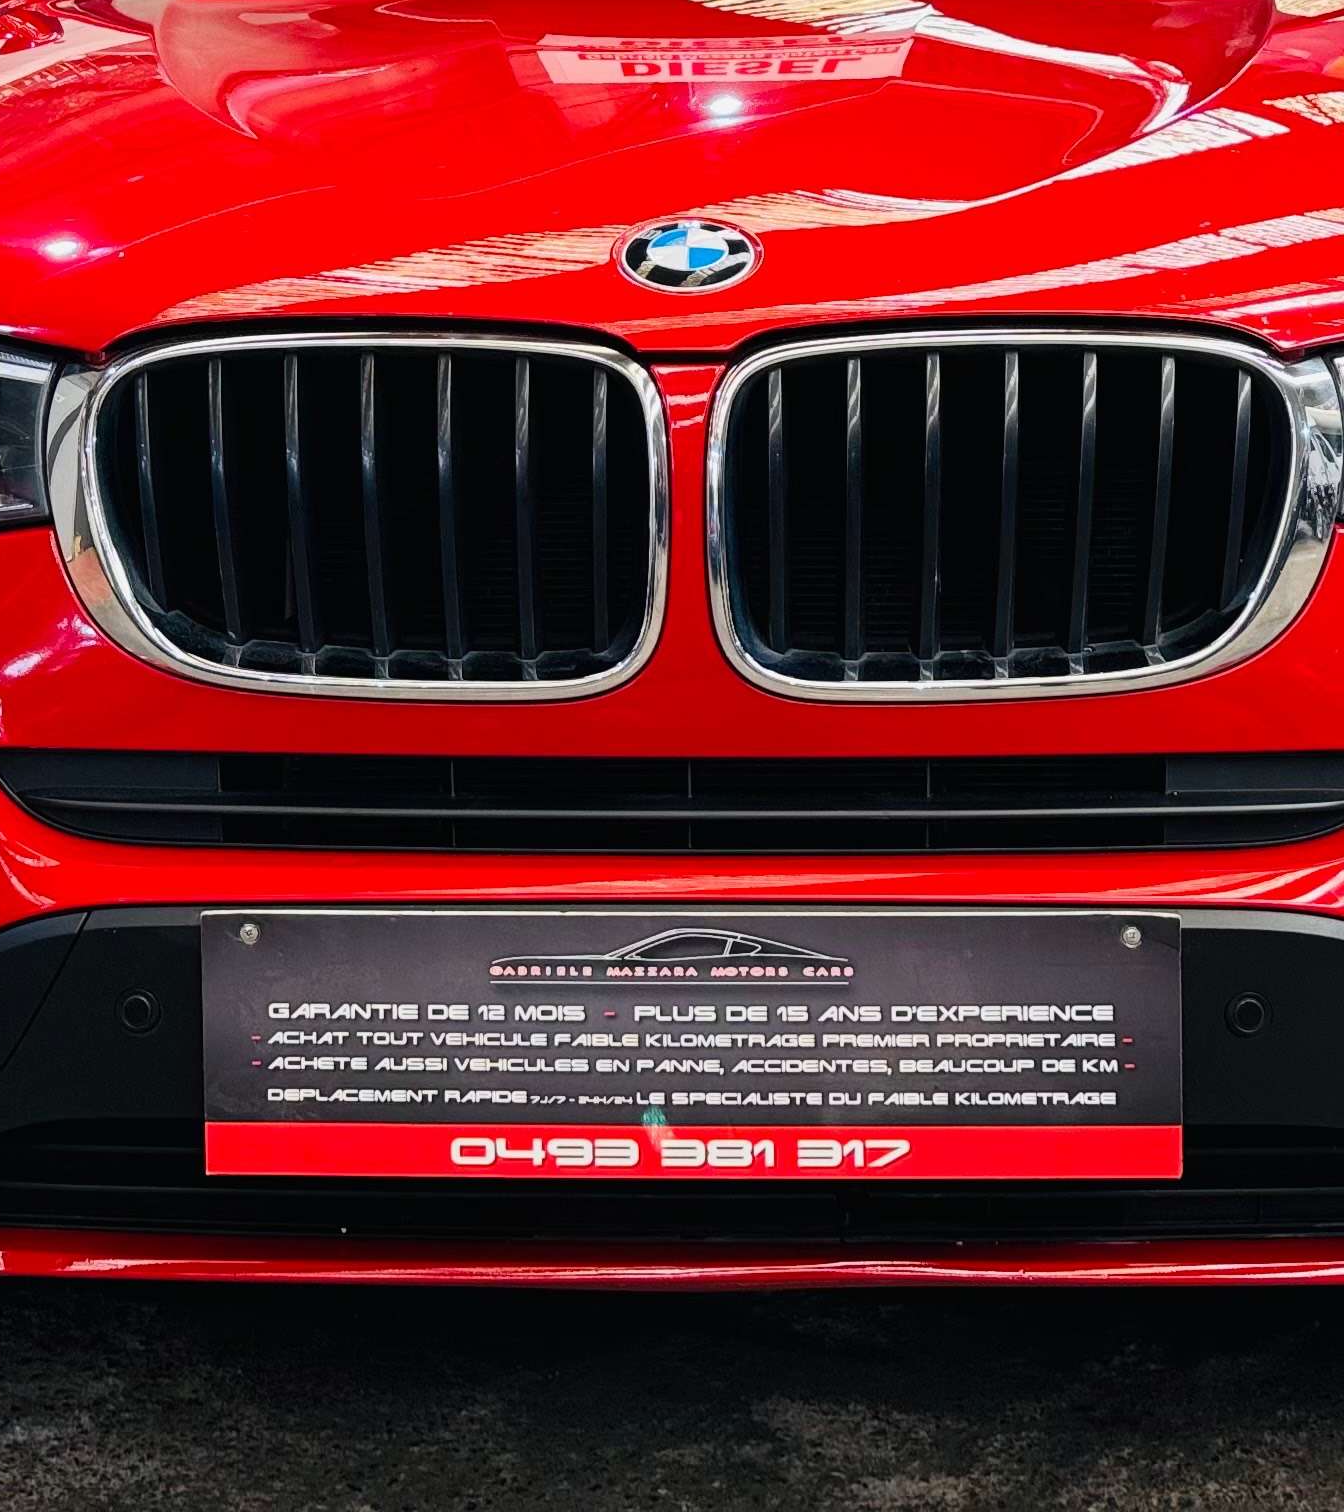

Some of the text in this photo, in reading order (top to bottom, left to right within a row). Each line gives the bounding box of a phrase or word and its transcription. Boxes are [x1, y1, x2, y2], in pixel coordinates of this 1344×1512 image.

[489, 966, 855, 977] GABRIELE MAZZARA MOTORS CARS
[268, 1002, 419, 1020] GARANTIE
[427, 1004, 470, 1021] DE
[477, 1004, 505, 1021] 12
[514, 1004, 586, 1022] MOIS
[633, 1005, 717, 1022] PLUS
[725, 1005, 768, 1022] DE
[776, 1005, 809, 1022] 15
[817, 1005, 882, 1022] ANS
[890, 1004, 1114, 1022] D'EXPERIENCE
[267, 1031, 350, 1045] ACHAT
[356, 1031, 424, 1046] TOUT
[429, 1032, 548, 1047] VEHICULE
[553, 1033, 639, 1047] FAIBLE
[645, 1033, 816, 1048] KILOMETRAGE
[822, 1033, 930, 1048] PREMIER
[936, 1033, 1116, 1048] PROPRIETAIRE
[267, 1056, 368, 1071] ACHETE
[374, 1057, 448, 1072] AUSSI
[453, 1057, 590, 1072] VEHICULES
[595, 1058, 630, 1073] EN
[636, 1059, 725, 1076] PANNE,
[731, 1059, 893, 1076] ACCIDENTES,
[898, 1059, 1035, 1073] BEAUCOUP
[1041, 1058, 1076, 1073] DE
[1082, 1058, 1119, 1073] KM
[267, 1088, 439, 1103] DEPLACEMENT
[444, 1089, 528, 1104] RAPIDE
[636, 1091, 666, 1105] LE
[671, 1092, 823, 1106] SPECIALISTE
[828, 1092, 862, 1106] DU
[867, 1092, 949, 1106] FAIBLE
[954, 1091, 1117, 1106] KILOMETRAGE
[450, 1137, 911, 1168] 0493 381 317
